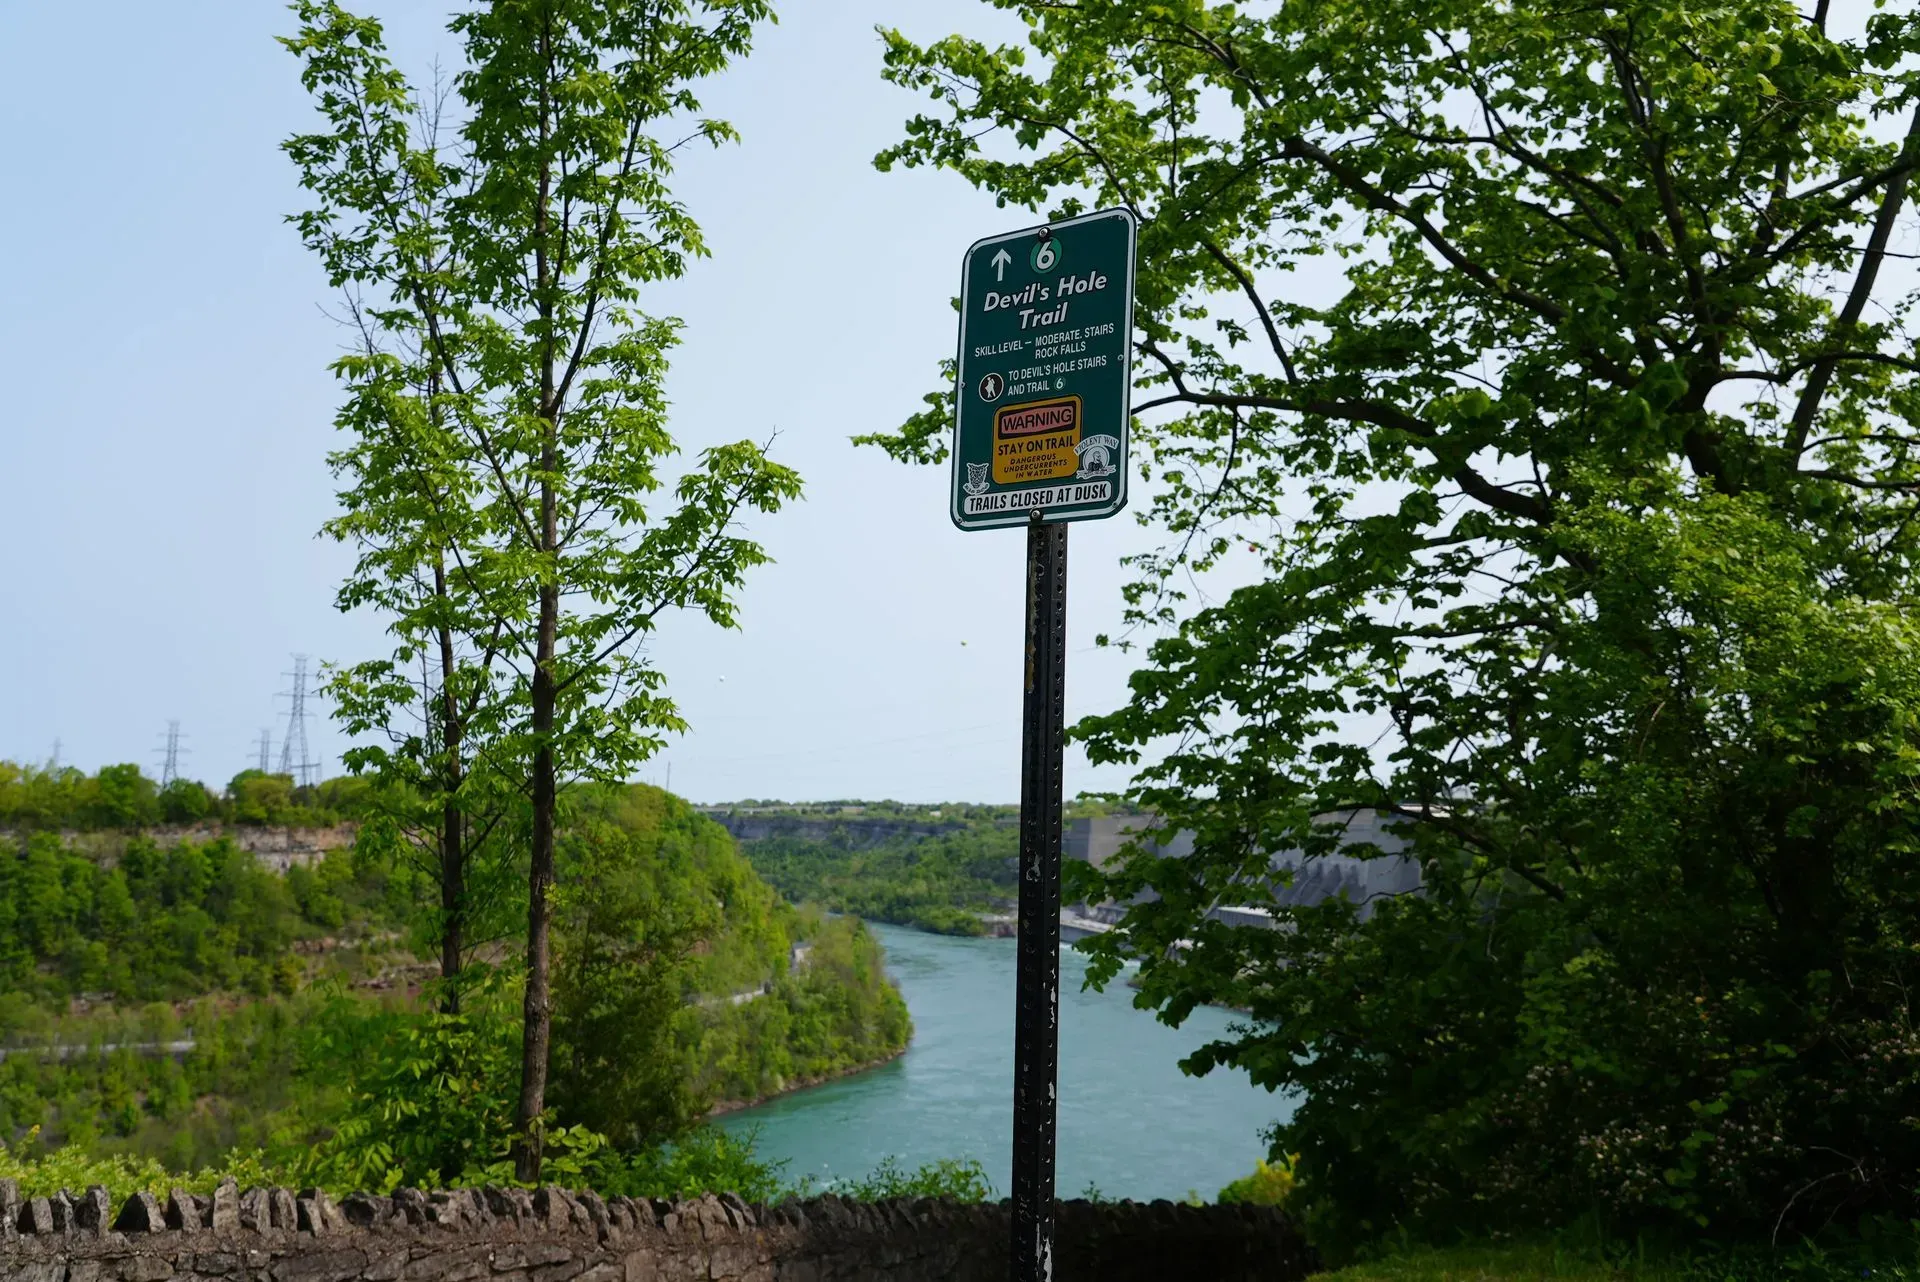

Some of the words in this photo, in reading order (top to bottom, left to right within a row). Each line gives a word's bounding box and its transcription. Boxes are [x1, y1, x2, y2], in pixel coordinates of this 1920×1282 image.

[1036, 240, 1056, 270] 6
[983, 282, 1050, 312] Devil's
[1057, 270, 1107, 297] Hole
[1019, 302, 1068, 330] Trail
[974, 345, 996, 358] SKILL
[998, 340, 1023, 354] LEVEL
[1084, 322, 1114, 339] STAIRS
[1035, 345, 1058, 359] ROCK
[1060, 341, 1086, 355] FALLS
[1008, 370, 1019, 381] TO
[1021, 365, 1051, 379] DEVIL'S
[1052, 360, 1075, 374] HOLE
[1077, 355, 1107, 370] STAIRS
[1007, 384, 1025, 396] AND
[1027, 380, 1050, 393] TRAIL
[1055, 377, 1064, 390] 6
[1003, 409, 1072, 431] WARNING
[998, 442, 1024, 456] STAY
[1026, 440, 1043, 452] ON
[1046, 435, 1075, 450] TRAIL
[1104, 436, 1118, 449] WAY
[1003, 459, 1068, 473] UNDERCURRENTS
[1010, 453, 1057, 465] DANGEROUS
[1027, 468, 1053, 478] WATER
[970, 494, 1007, 512] TRAILS
[1010, 489, 1053, 510] CLOSED
[1056, 487, 1071, 503] AT
[1074, 483, 1107, 501] DUSK
